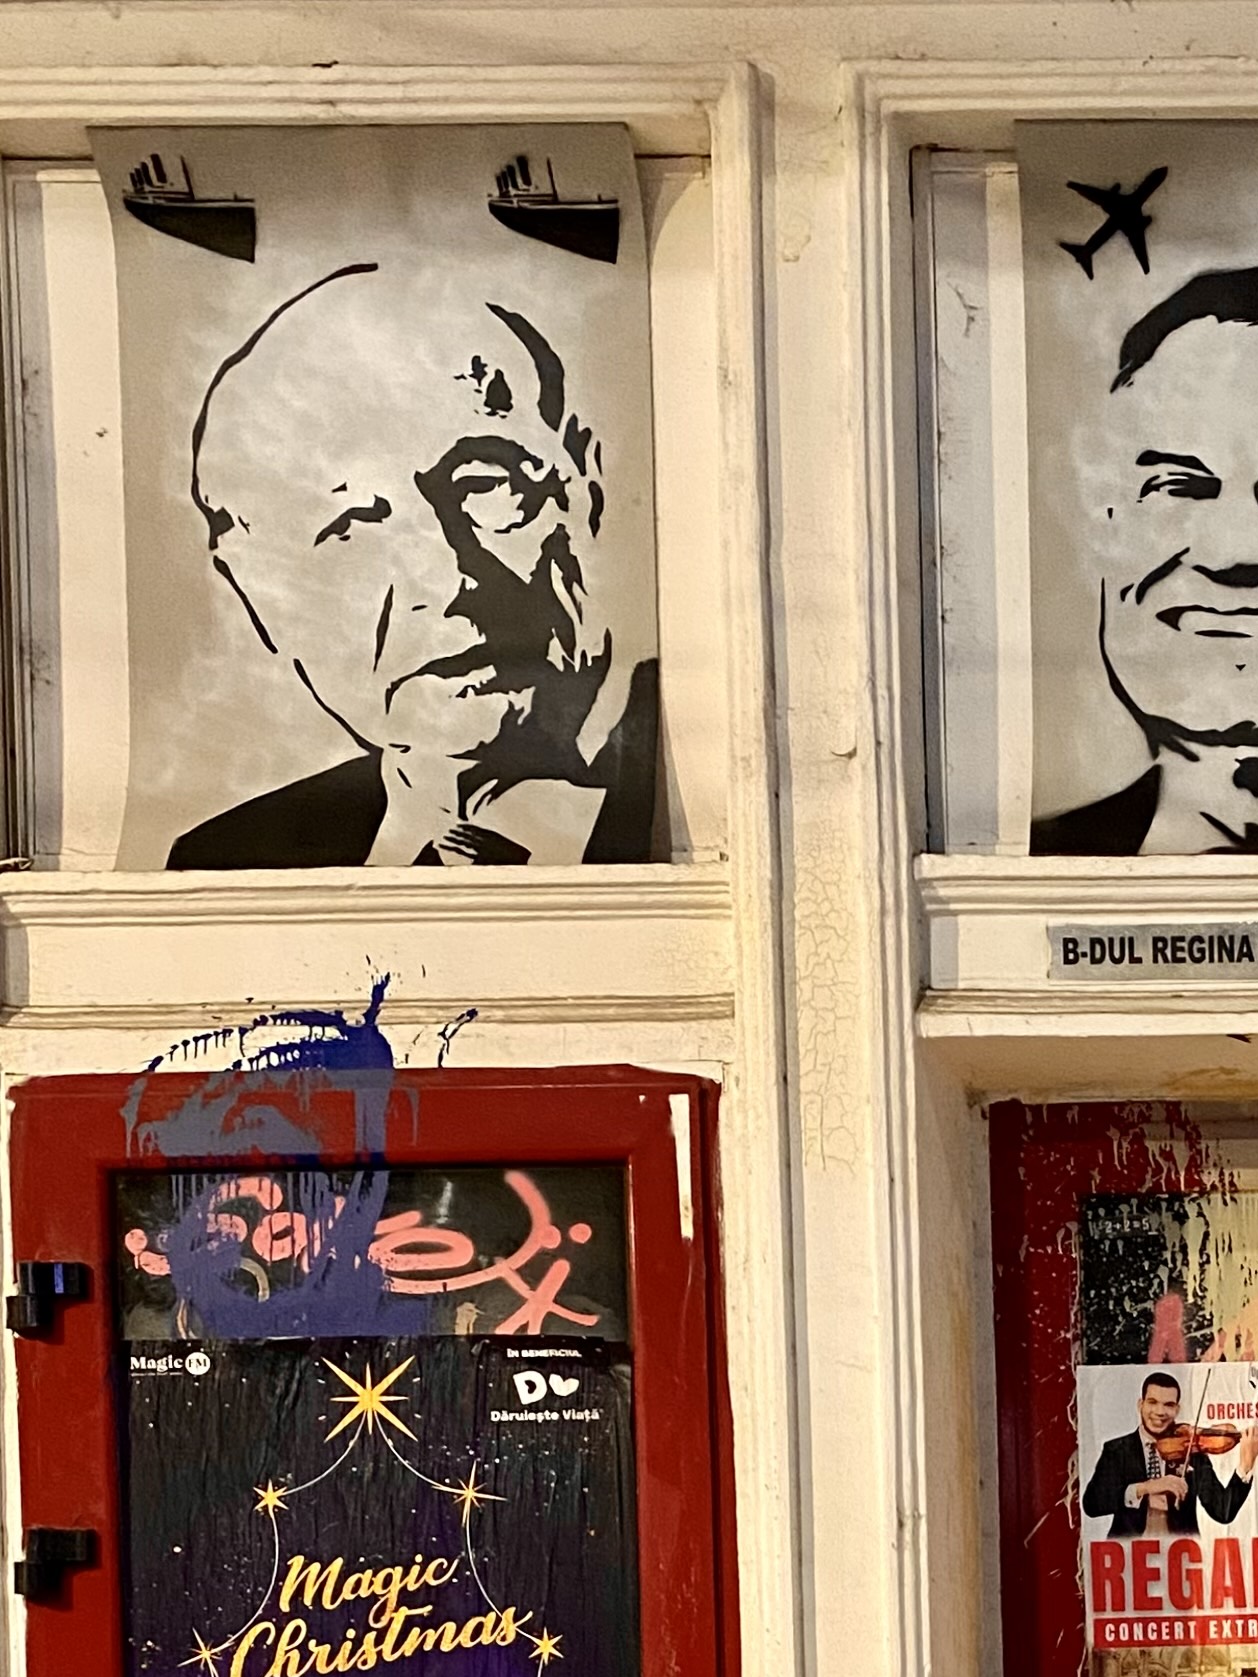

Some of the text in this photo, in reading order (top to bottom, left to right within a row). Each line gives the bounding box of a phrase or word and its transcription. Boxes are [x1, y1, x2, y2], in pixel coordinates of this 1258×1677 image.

[1062, 935, 1143, 966] B-DUL
[1151, 934, 1255, 965] REGINA
[130, 1354, 184, 1373] Magic
[279, 1553, 459, 1629] Magic
[1104, 1620, 1197, 1642] CONCERT
